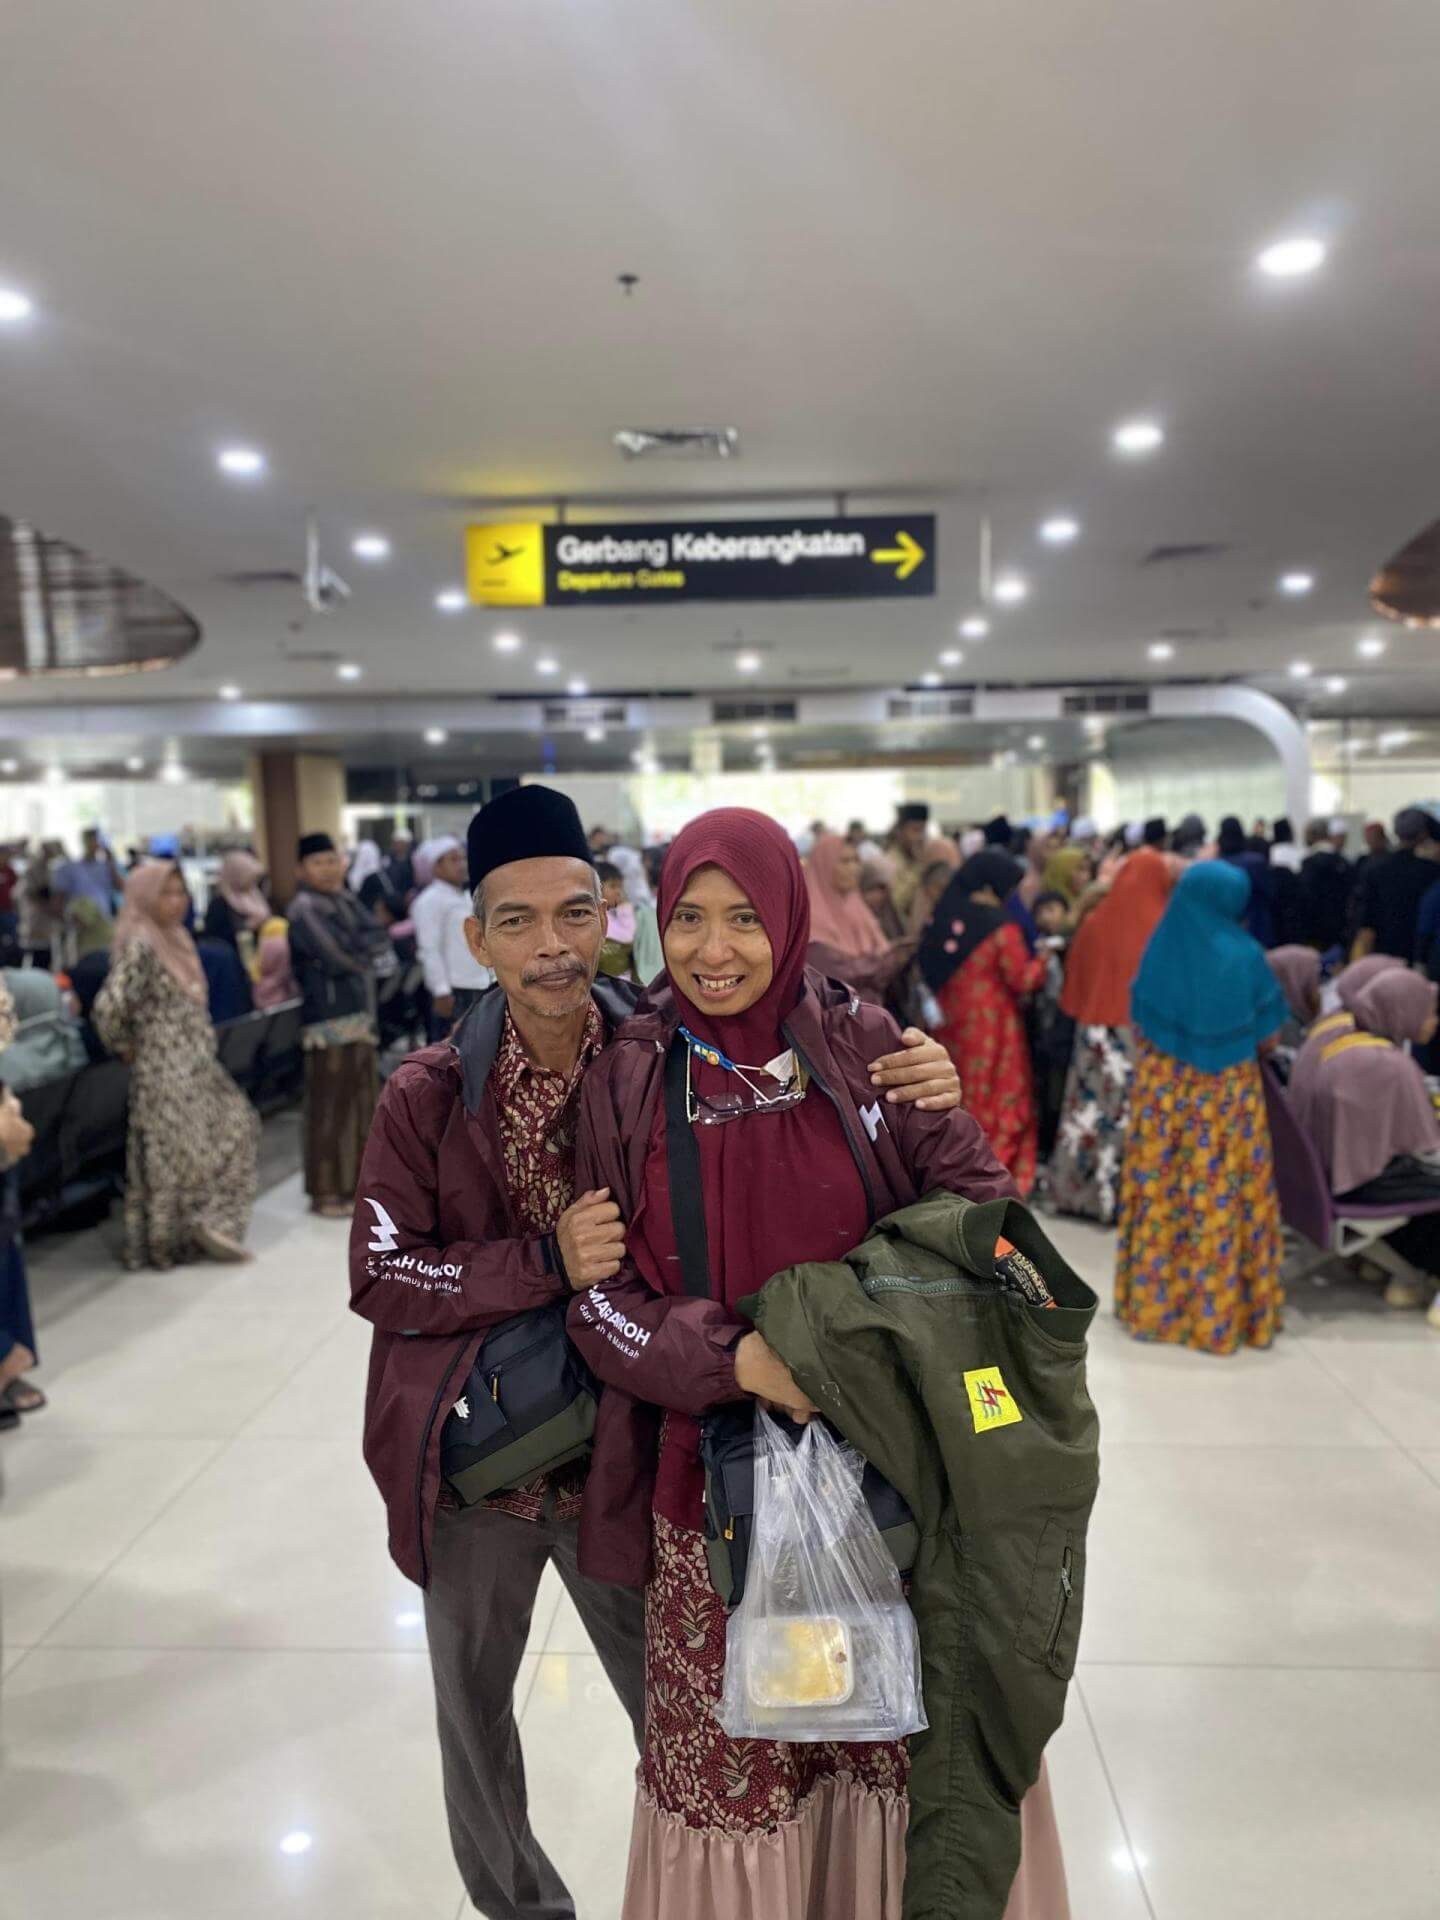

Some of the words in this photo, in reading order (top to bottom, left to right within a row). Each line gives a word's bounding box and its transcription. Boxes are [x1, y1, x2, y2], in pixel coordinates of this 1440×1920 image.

[557, 535, 667, 567] Gerbang
[673, 531, 864, 564] Keberangkatan
[558, 571, 634, 591] Departure
